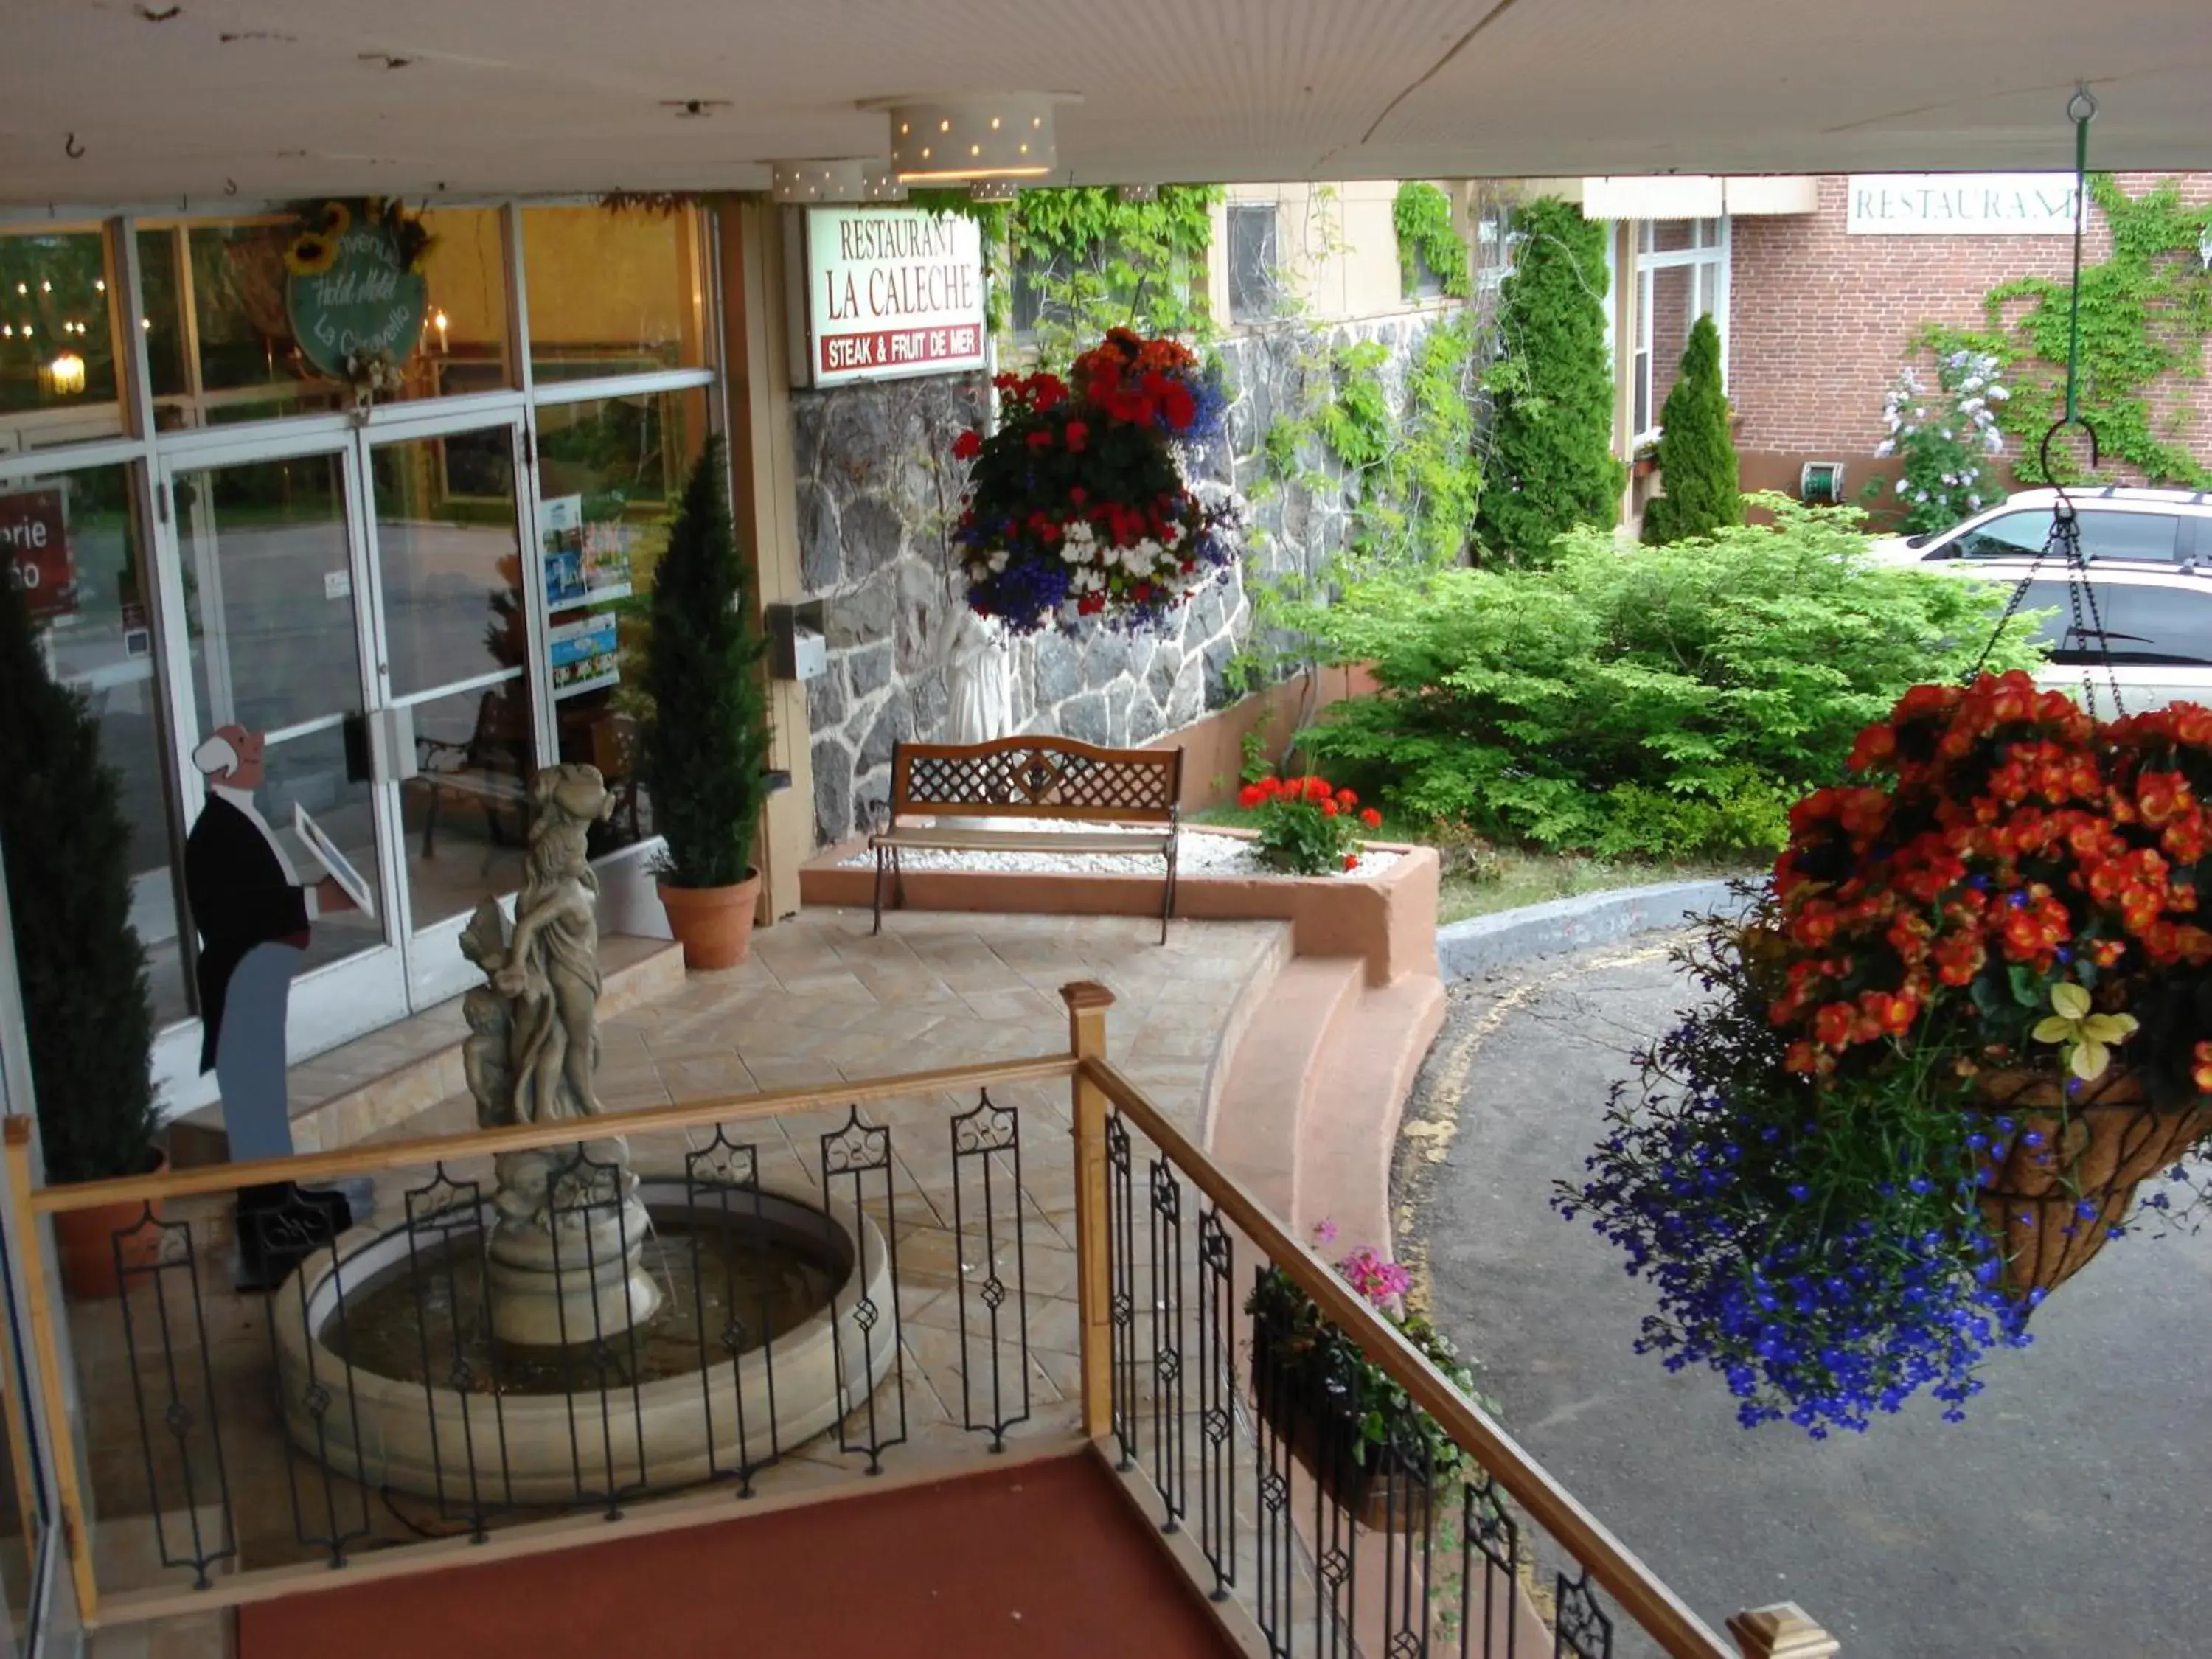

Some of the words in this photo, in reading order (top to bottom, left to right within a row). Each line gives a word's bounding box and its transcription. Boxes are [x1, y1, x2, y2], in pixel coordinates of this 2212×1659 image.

[1855, 187, 2079, 219] RESTAURANT
[840, 218, 958, 260] RESTAURANT
[825, 269, 860, 320] LA
[869, 263, 973, 316] CALECHE
[313, 311, 335, 347] La
[828, 335, 873, 367] STEAK
[877, 334, 886, 361] &
[891, 332, 926, 361] FRUIT
[931, 330, 947, 357] DE
[950, 328, 975, 355] MER
[0, 515, 47, 549] rie
